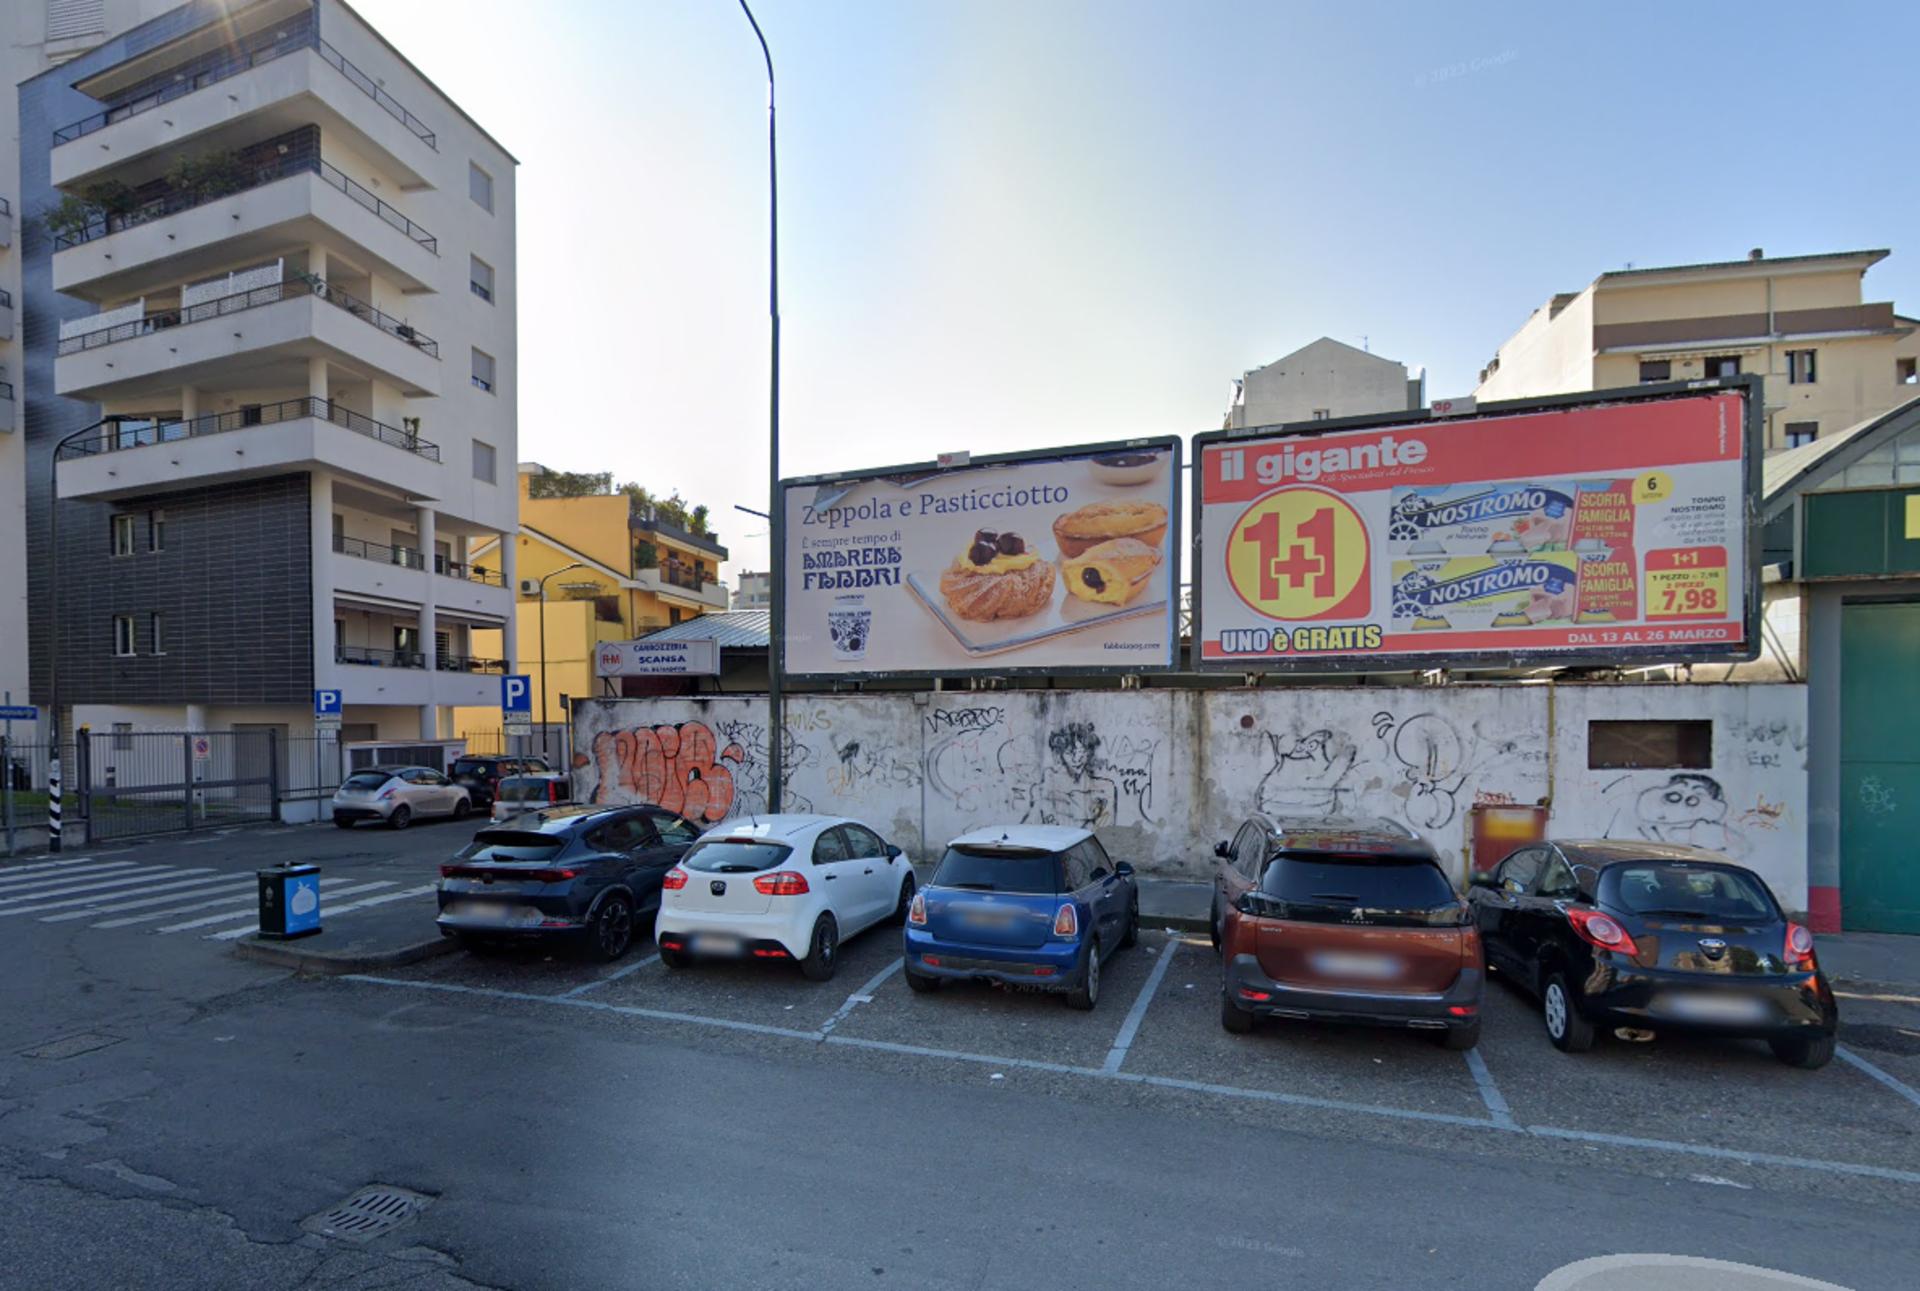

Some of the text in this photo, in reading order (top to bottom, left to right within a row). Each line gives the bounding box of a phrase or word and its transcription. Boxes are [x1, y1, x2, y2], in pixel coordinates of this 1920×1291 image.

[1433, 401, 1452, 413] ap
[1220, 436, 1428, 485] il gigante
[1647, 477, 1657, 490] 6
[802, 484, 1069, 529] Zeppola e Pasticciotto
[1580, 492, 1627, 507] SCORTA
[1670, 503, 1726, 513] NOSTROMO
[1691, 495, 1726, 504] TONNO
[1426, 490, 1547, 527] NOSTROMO
[1577, 508, 1631, 523] FAMIGLIA
[811, 537, 850, 550] sempre
[852, 534, 887, 546] tempo
[890, 530, 901, 542] di
[802, 546, 903, 569] AMARENA
[1671, 551, 1699, 566] 1+1
[1583, 562, 1629, 577] SCORTA
[802, 567, 901, 590] FABBRI
[1429, 565, 1550, 605] NOSTROMO
[1580, 577, 1635, 592] FAMIGLIA
[1662, 587, 1718, 613] 7,98
[1221, 624, 1382, 652] UNO è GRATIS
[1568, 628, 1727, 643] DAL 13 AL 26 MARZO
[638, 655, 687, 664] SCANSA
[320, 692, 337, 711] P
[506, 679, 525, 707] P
